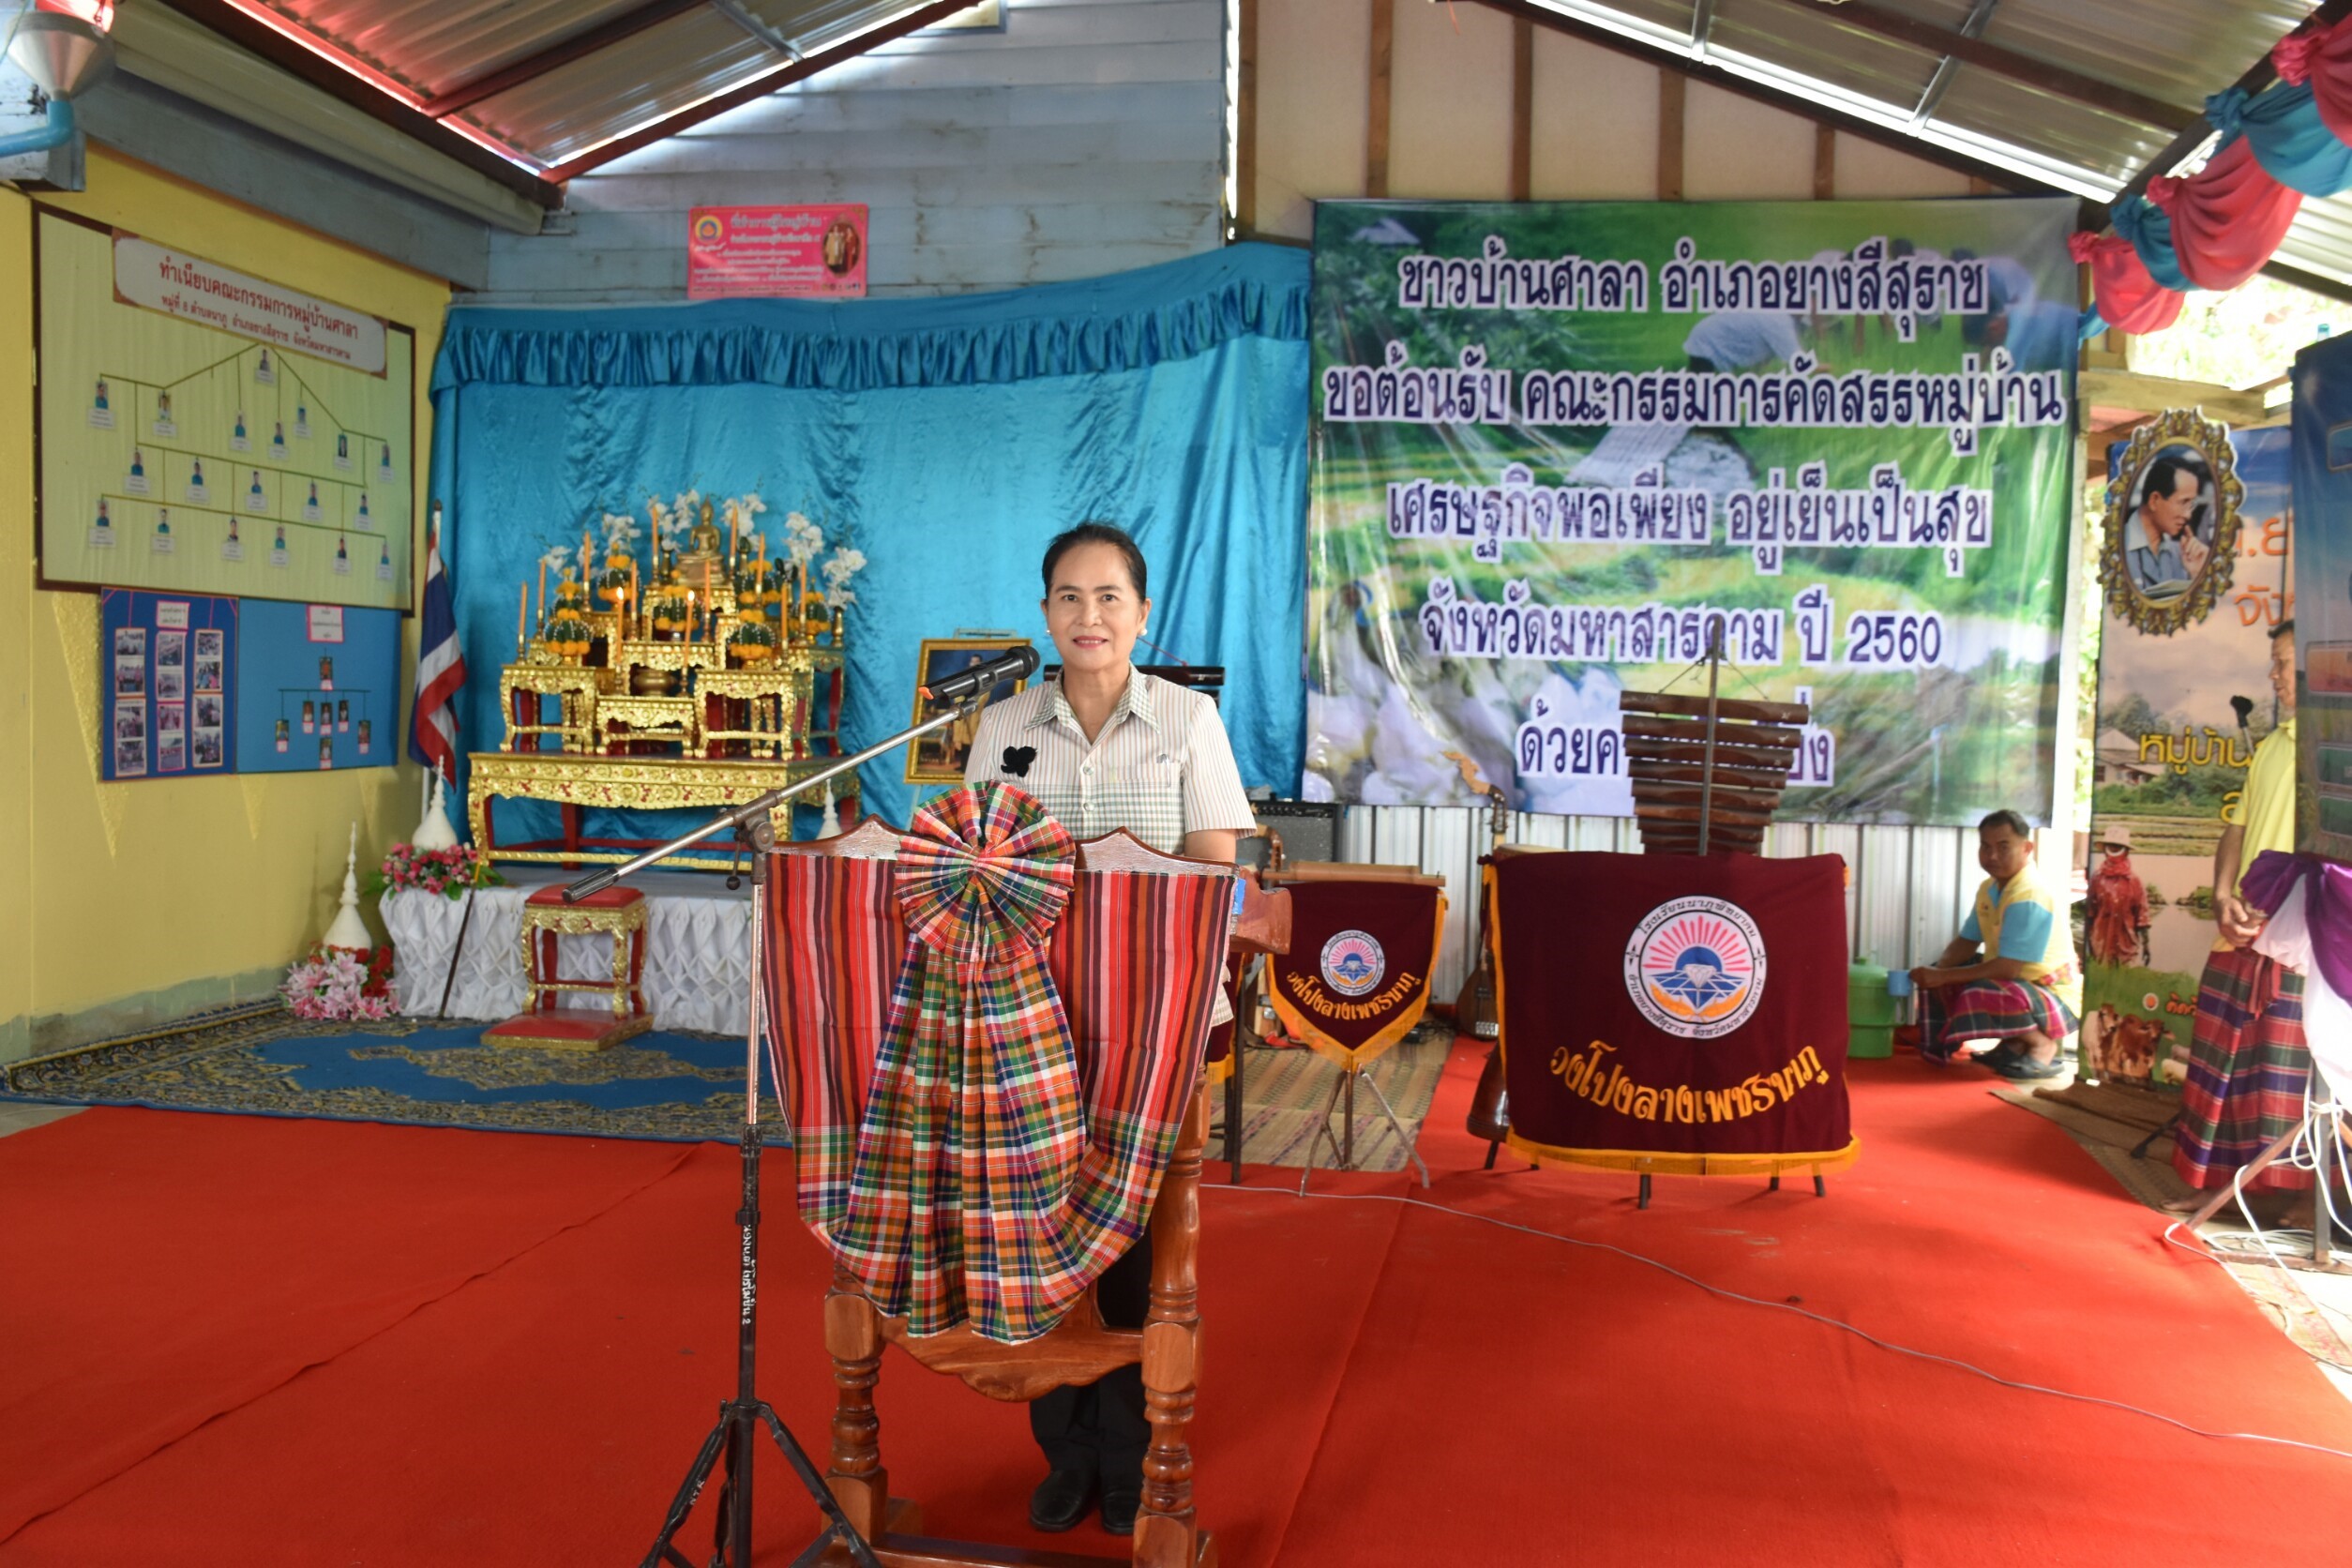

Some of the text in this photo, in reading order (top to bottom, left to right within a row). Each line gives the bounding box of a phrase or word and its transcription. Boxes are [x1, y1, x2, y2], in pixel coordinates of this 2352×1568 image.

[159, 255, 358, 339] ทำเนียบคณะกรรมการหมู่บ้านศาลา
[1401, 237, 1985, 339] ชาวบ้านศาลา อำเภอยางสีสุราช
[1325, 343, 2063, 453] ขอต้อนรับ คณะกรรมการคัดสรรหมู่บ้าน
[1388, 463, 1990, 574] เศรษฐกิจพอเพียง อยู่เย็นเป็นสุข
[1800, 588, 1829, 663] ปี
[1850, 615, 1942, 664] 2560
